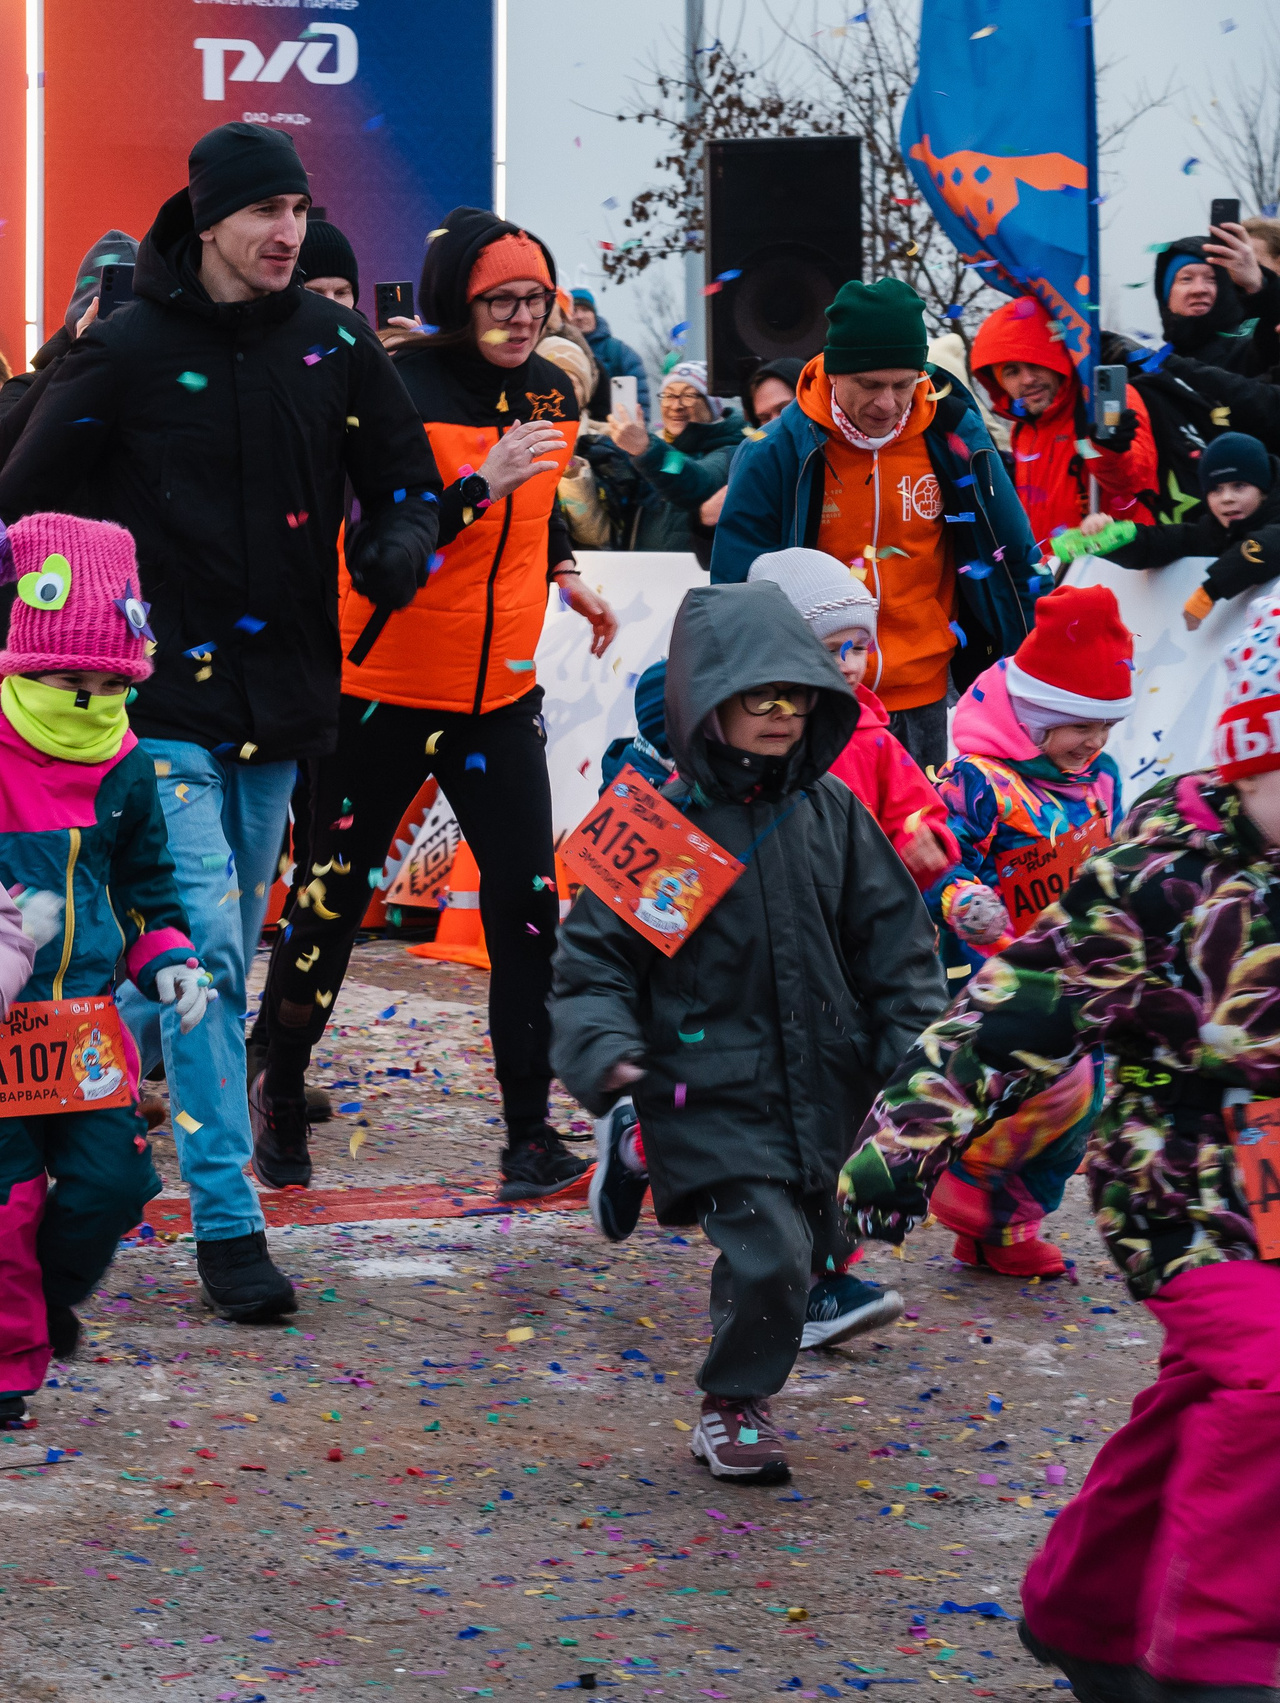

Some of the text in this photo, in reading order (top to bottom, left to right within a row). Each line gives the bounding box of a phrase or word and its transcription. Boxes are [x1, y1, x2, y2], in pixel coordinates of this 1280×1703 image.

[242, 112, 269, 123] ОАО
[581, 807, 662, 886] A152
[1010, 848, 1039, 868] FUN
[1026, 849, 1058, 873] RUN
[1014, 867, 1074, 918] A09
[2, 1007, 28, 1025] UN
[10, 1014, 49, 1036] RUN
[0, 1088, 59, 1102] ВАРВАРА
